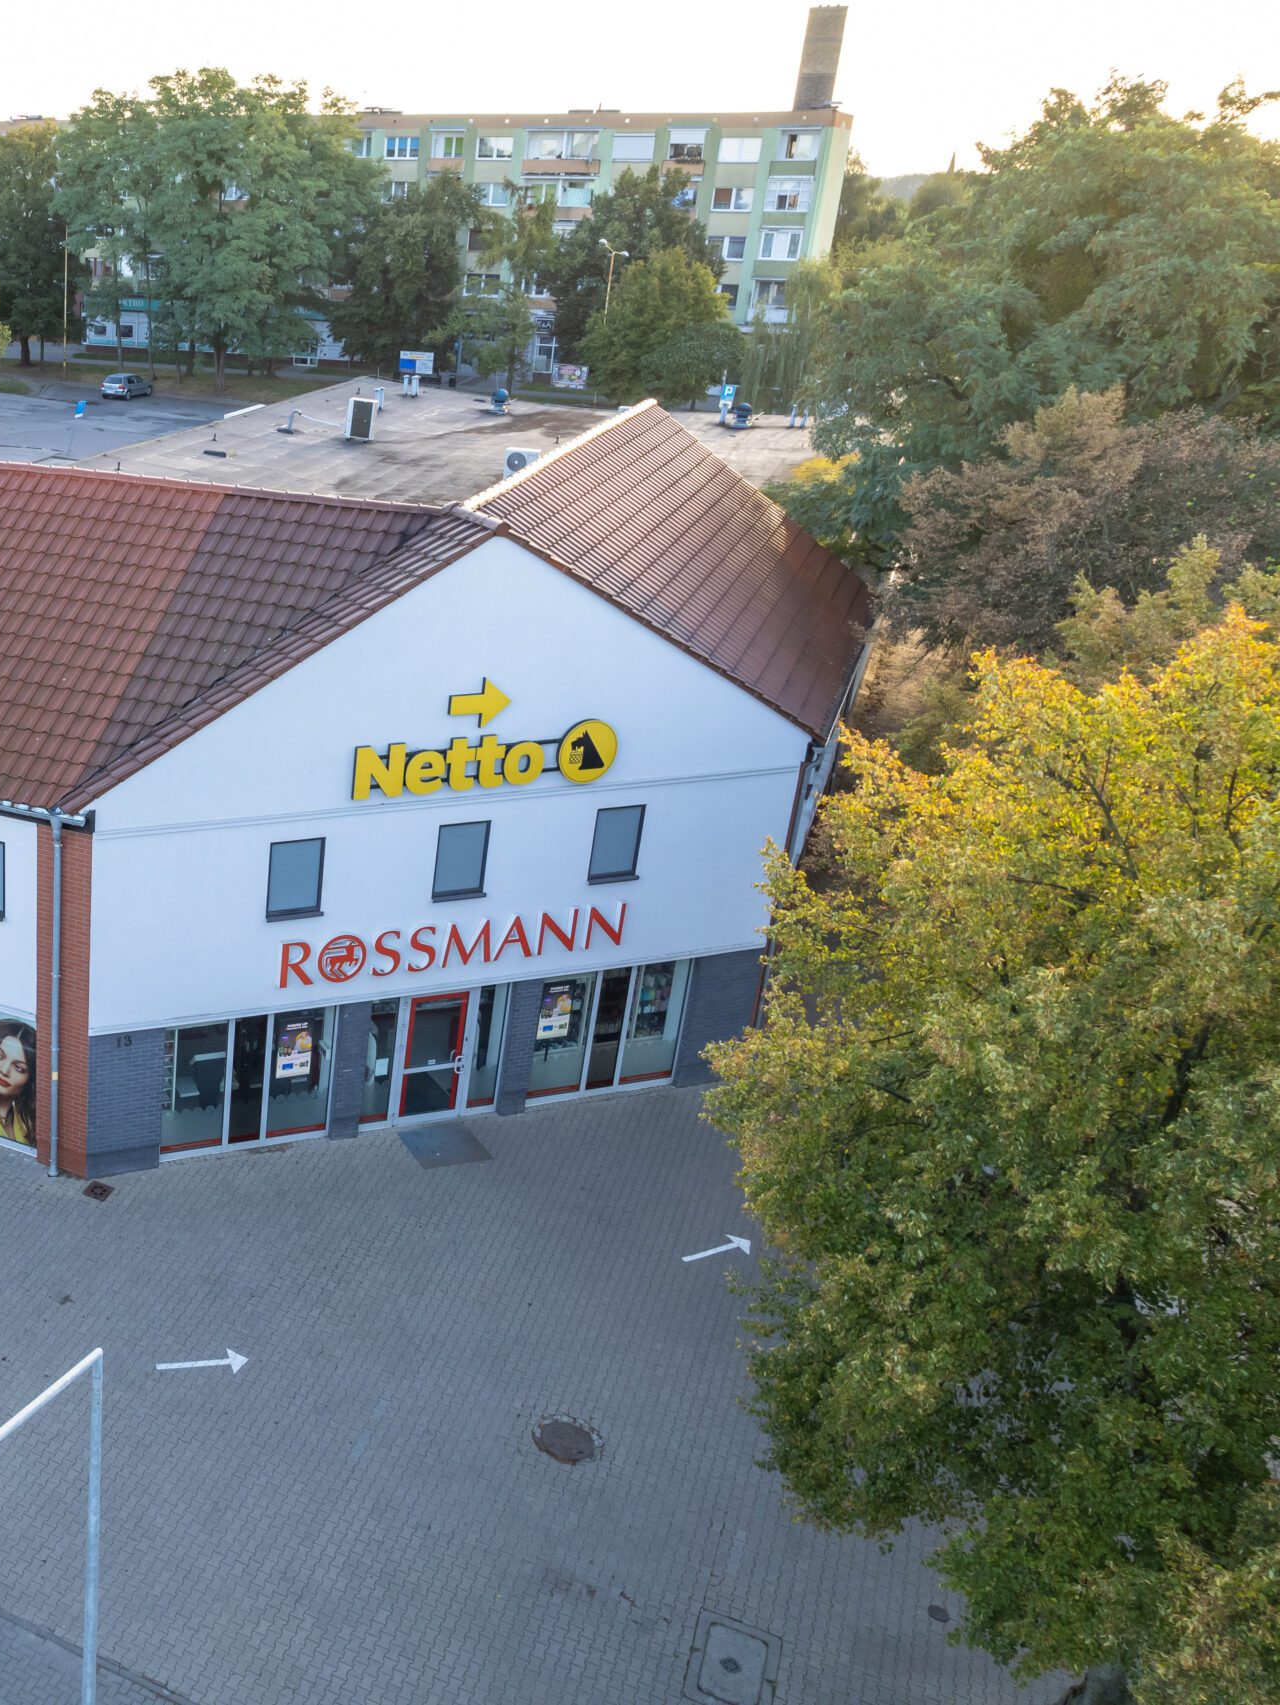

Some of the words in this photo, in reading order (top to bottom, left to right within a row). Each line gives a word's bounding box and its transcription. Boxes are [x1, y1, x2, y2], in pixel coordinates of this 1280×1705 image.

[724, 385, 734, 396] P
[351, 734, 545, 800] Netto
[277, 901, 628, 989] ROSSMANN
[116, 1034, 133, 1048] 13
